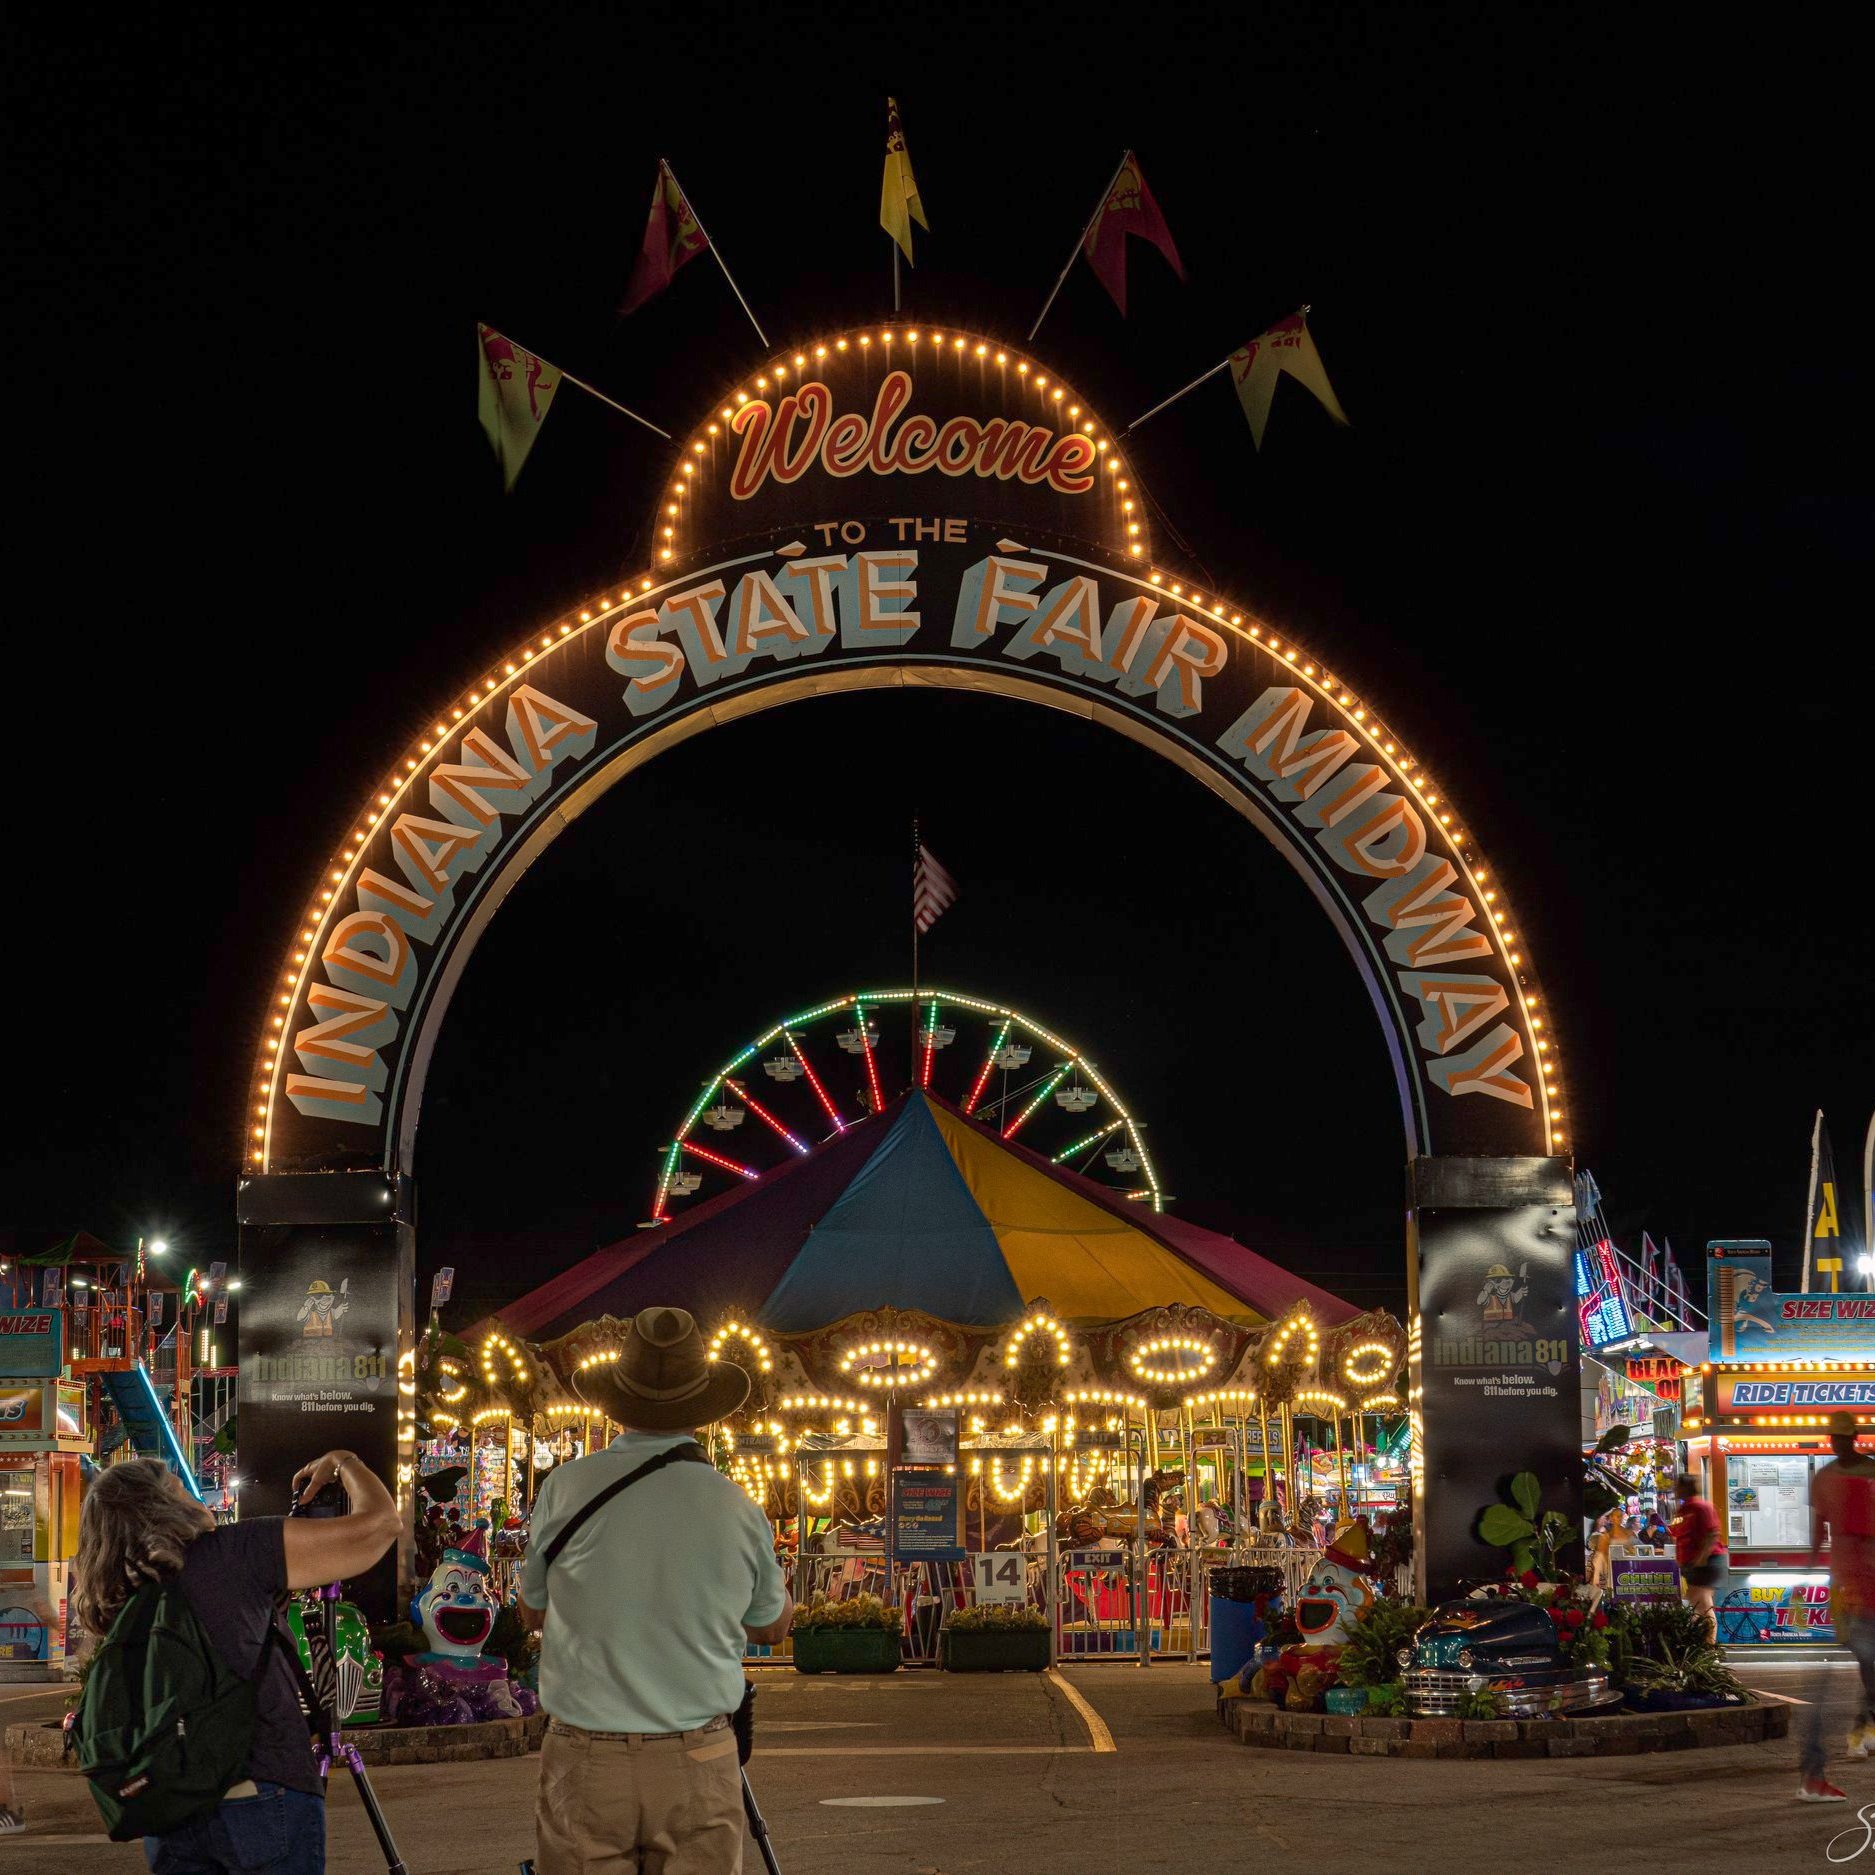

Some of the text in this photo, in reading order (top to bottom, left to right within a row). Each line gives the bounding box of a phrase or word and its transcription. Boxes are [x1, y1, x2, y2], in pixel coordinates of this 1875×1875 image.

[730, 370, 1097, 501] Welcome
[814, 516, 968, 547] TO THE
[285, 549, 1535, 1126] INDIANA STATE FAIR MIDWAY
[1781, 1300, 1833, 1320] SIZE
[1433, 1338, 1568, 1366] Indiana 811
[252, 1353, 386, 1381] Indiana 811
[1627, 1358, 1681, 1379] BLAC
[1454, 1374, 1535, 1386] Know what's below.
[271, 1389, 352, 1402] Know what's below.
[1484, 1385, 1558, 1397] 811 before you dig.
[1732, 1381, 1875, 1406] RIDE TICKETS
[301, 1401, 375, 1413] 811 before you dig.
[1083, 1552, 1112, 1564] EXIT
[979, 1558, 1021, 1587] 14
[1749, 1585, 1831, 1606] BUY RID
[1774, 1607, 1835, 1628] TICK
